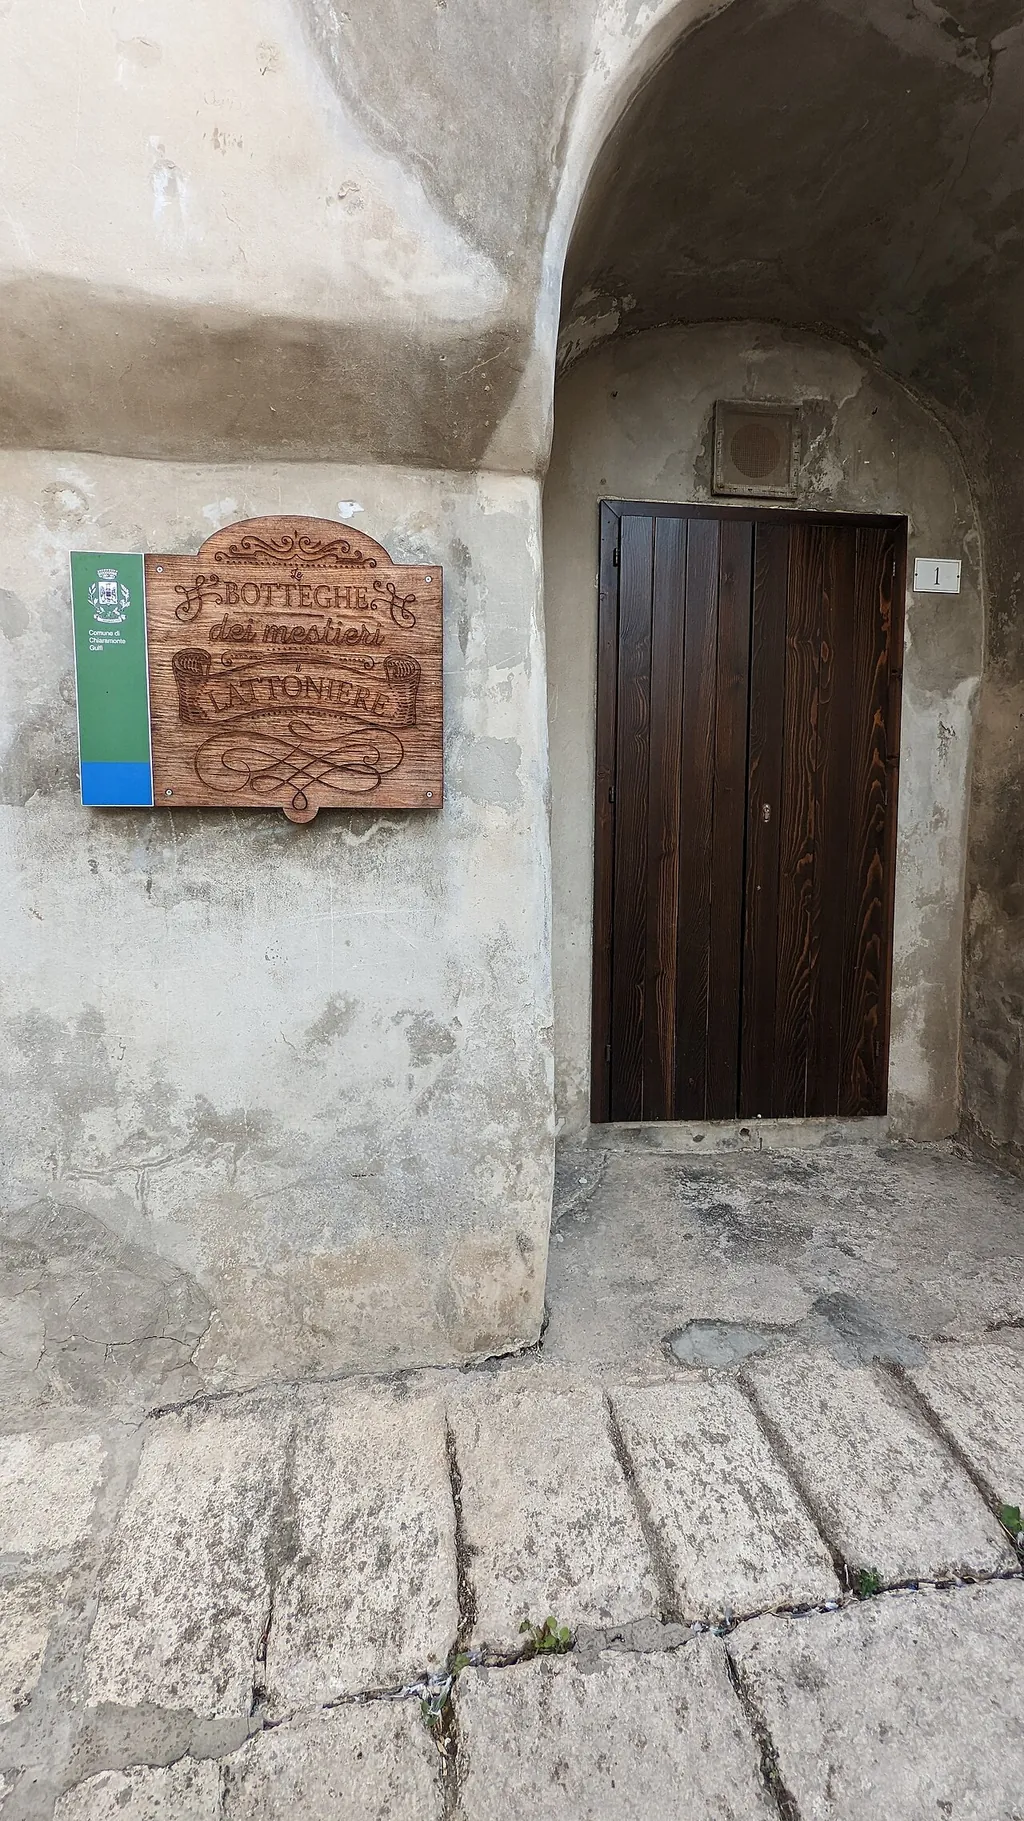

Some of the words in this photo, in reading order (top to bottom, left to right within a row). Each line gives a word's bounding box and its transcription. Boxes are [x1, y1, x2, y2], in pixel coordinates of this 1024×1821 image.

[933, 566, 941, 586] 1
[224, 582, 370, 609] BOTTEGHE
[209, 613, 257, 642] dei
[262, 618, 386, 646] mestieri
[206, 675, 389, 715] LATTONIERE
